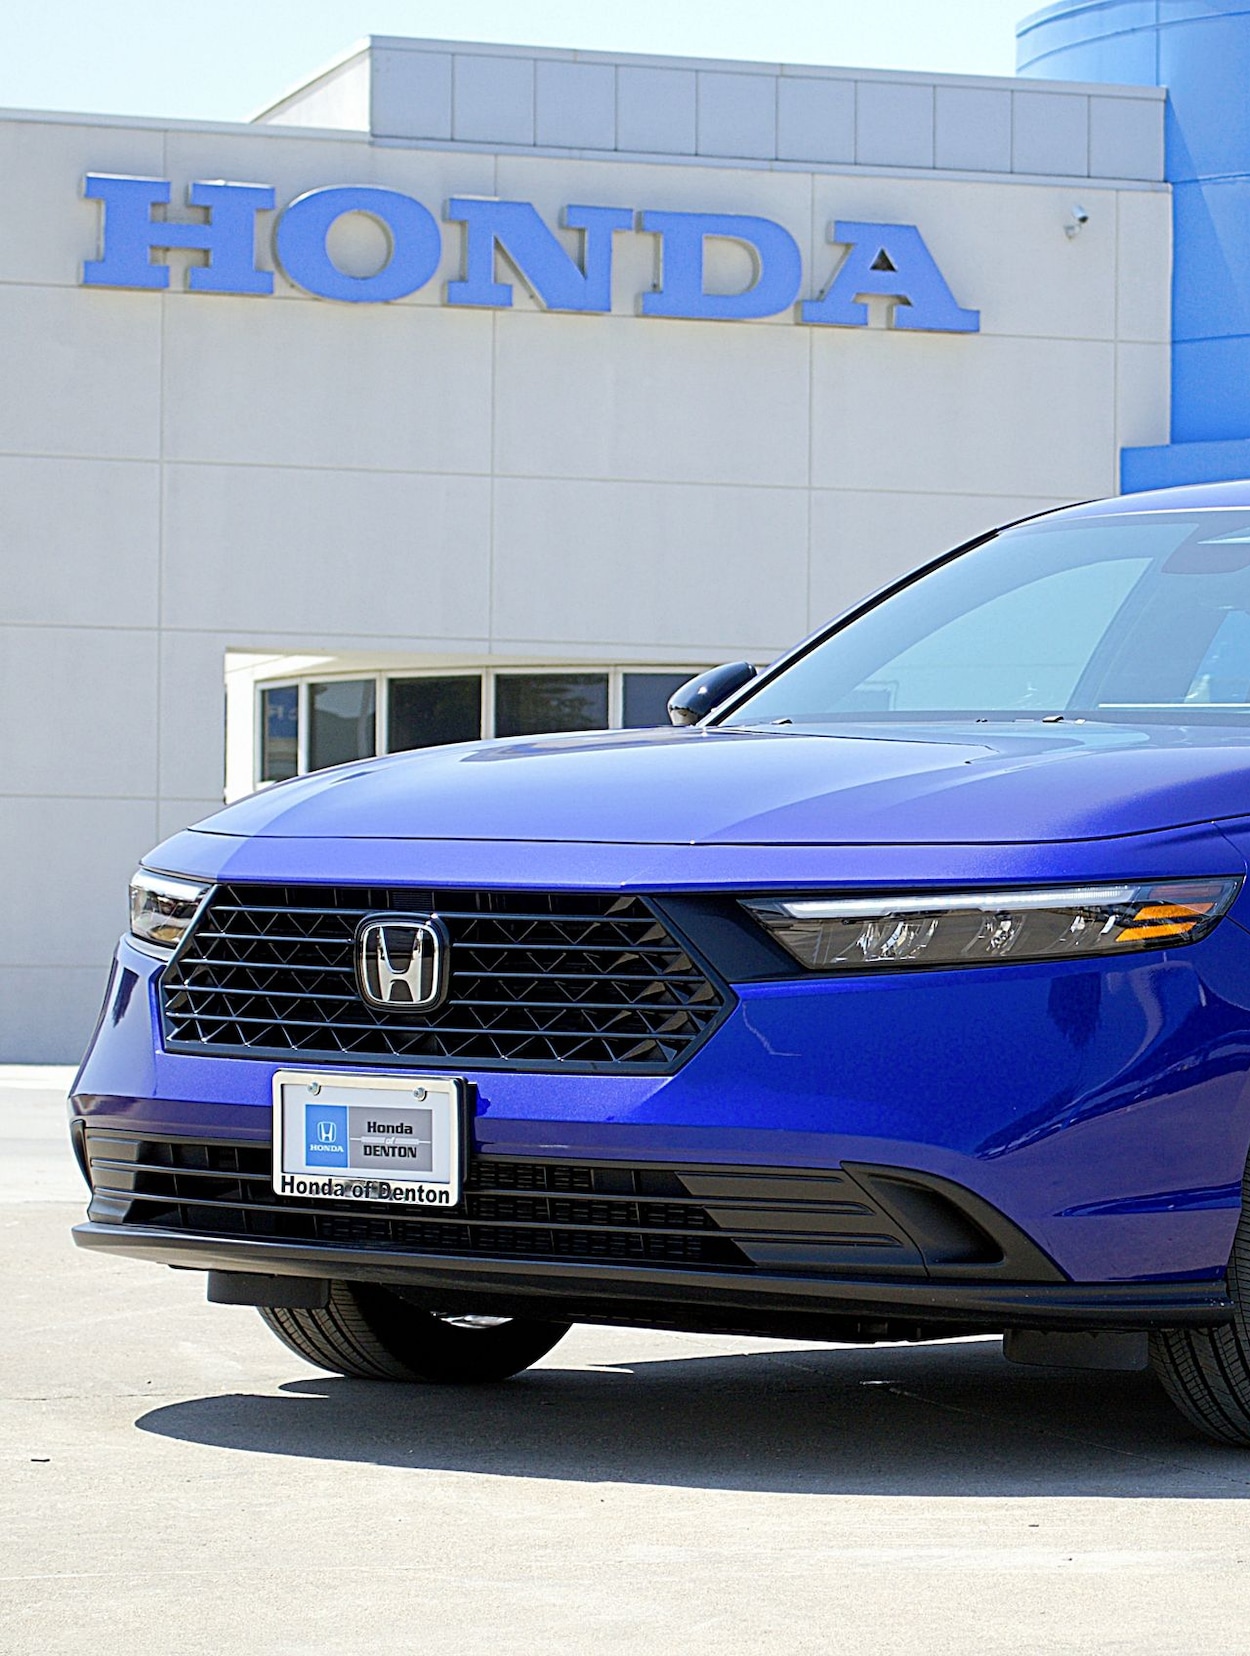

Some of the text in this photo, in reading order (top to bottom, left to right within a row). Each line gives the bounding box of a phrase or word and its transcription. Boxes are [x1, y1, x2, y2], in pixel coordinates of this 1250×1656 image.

[82, 172, 981, 334] HONDA
[367, 1121, 413, 1135] Honda
[309, 1144, 344, 1152] HONDA
[363, 1145, 417, 1158] DENTON
[281, 1175, 450, 1204] Honda of Denton
